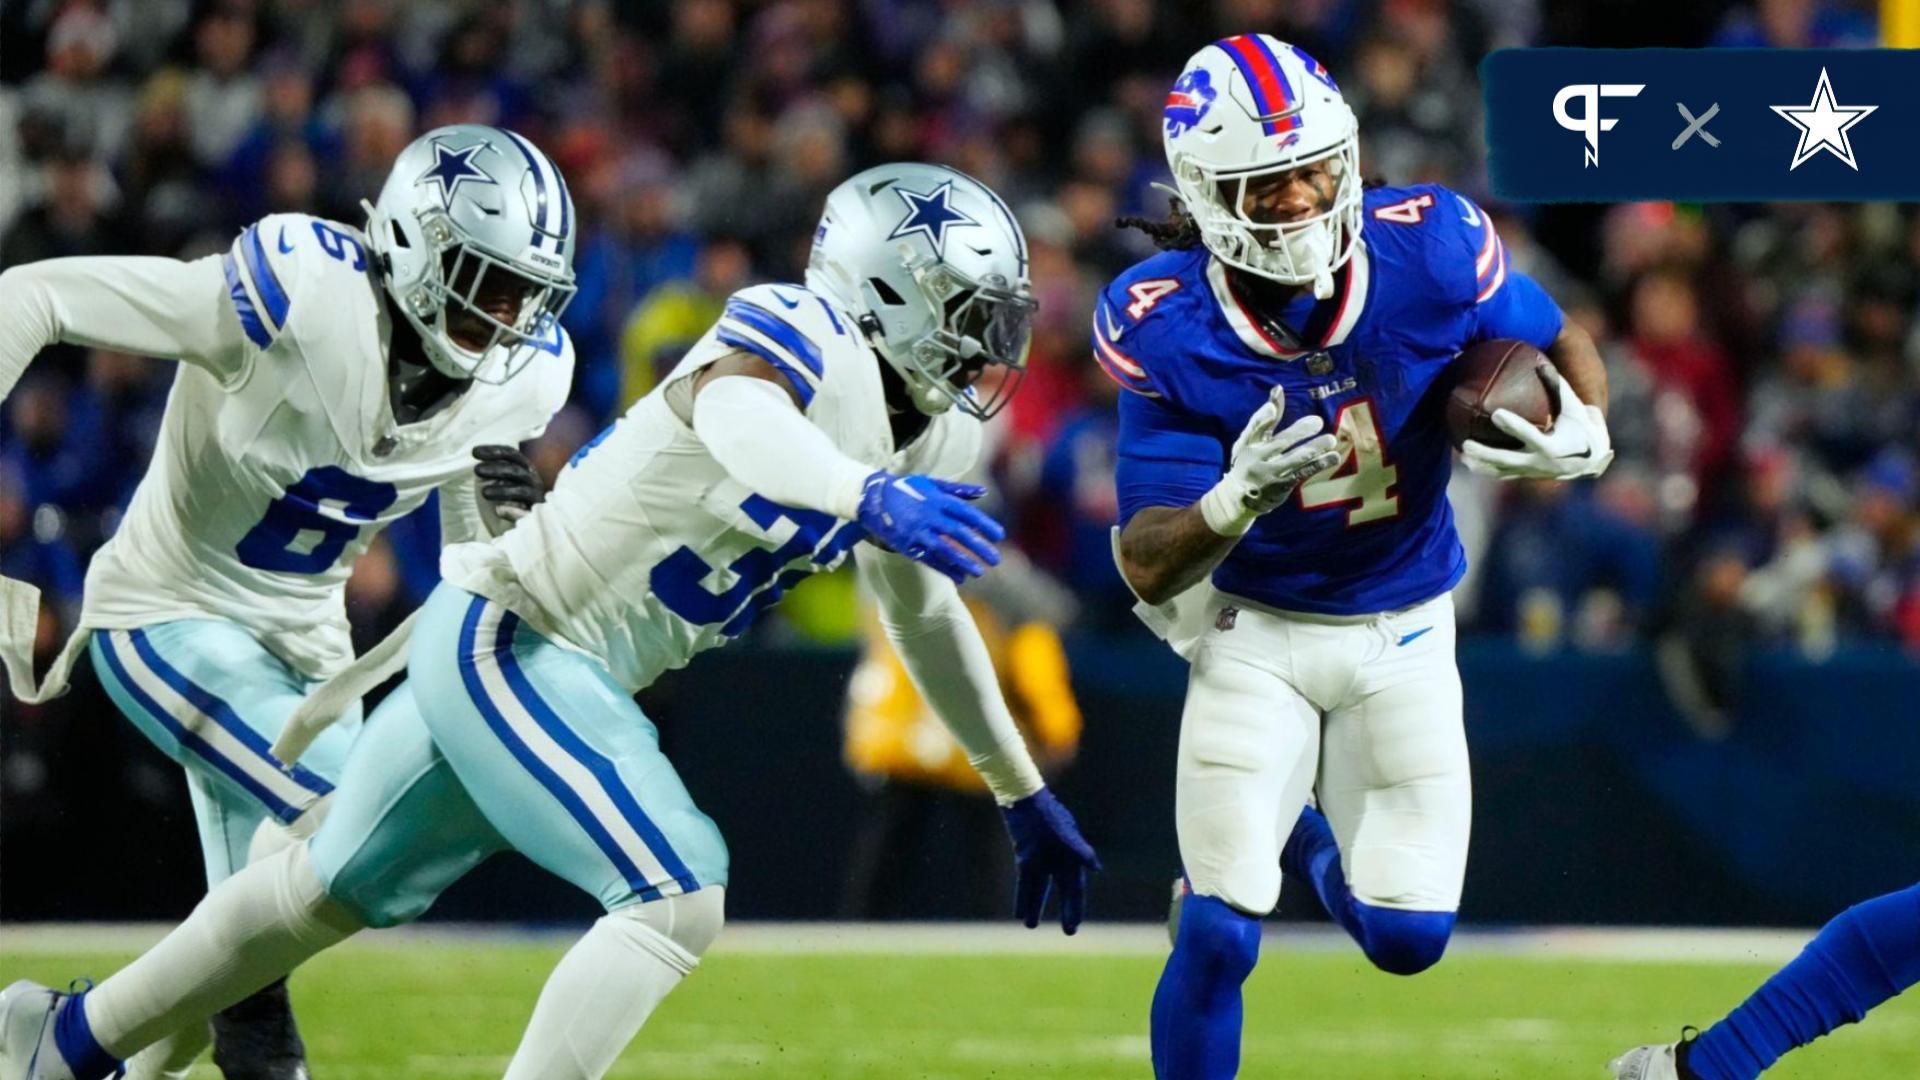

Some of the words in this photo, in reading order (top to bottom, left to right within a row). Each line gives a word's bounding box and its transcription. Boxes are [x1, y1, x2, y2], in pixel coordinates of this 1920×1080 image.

[1373, 193, 1434, 225] 4
[310, 220, 369, 273] 6
[1125, 276, 1183, 322] 4
[1297, 396, 1403, 530] 4
[235, 464, 398, 574] 6
